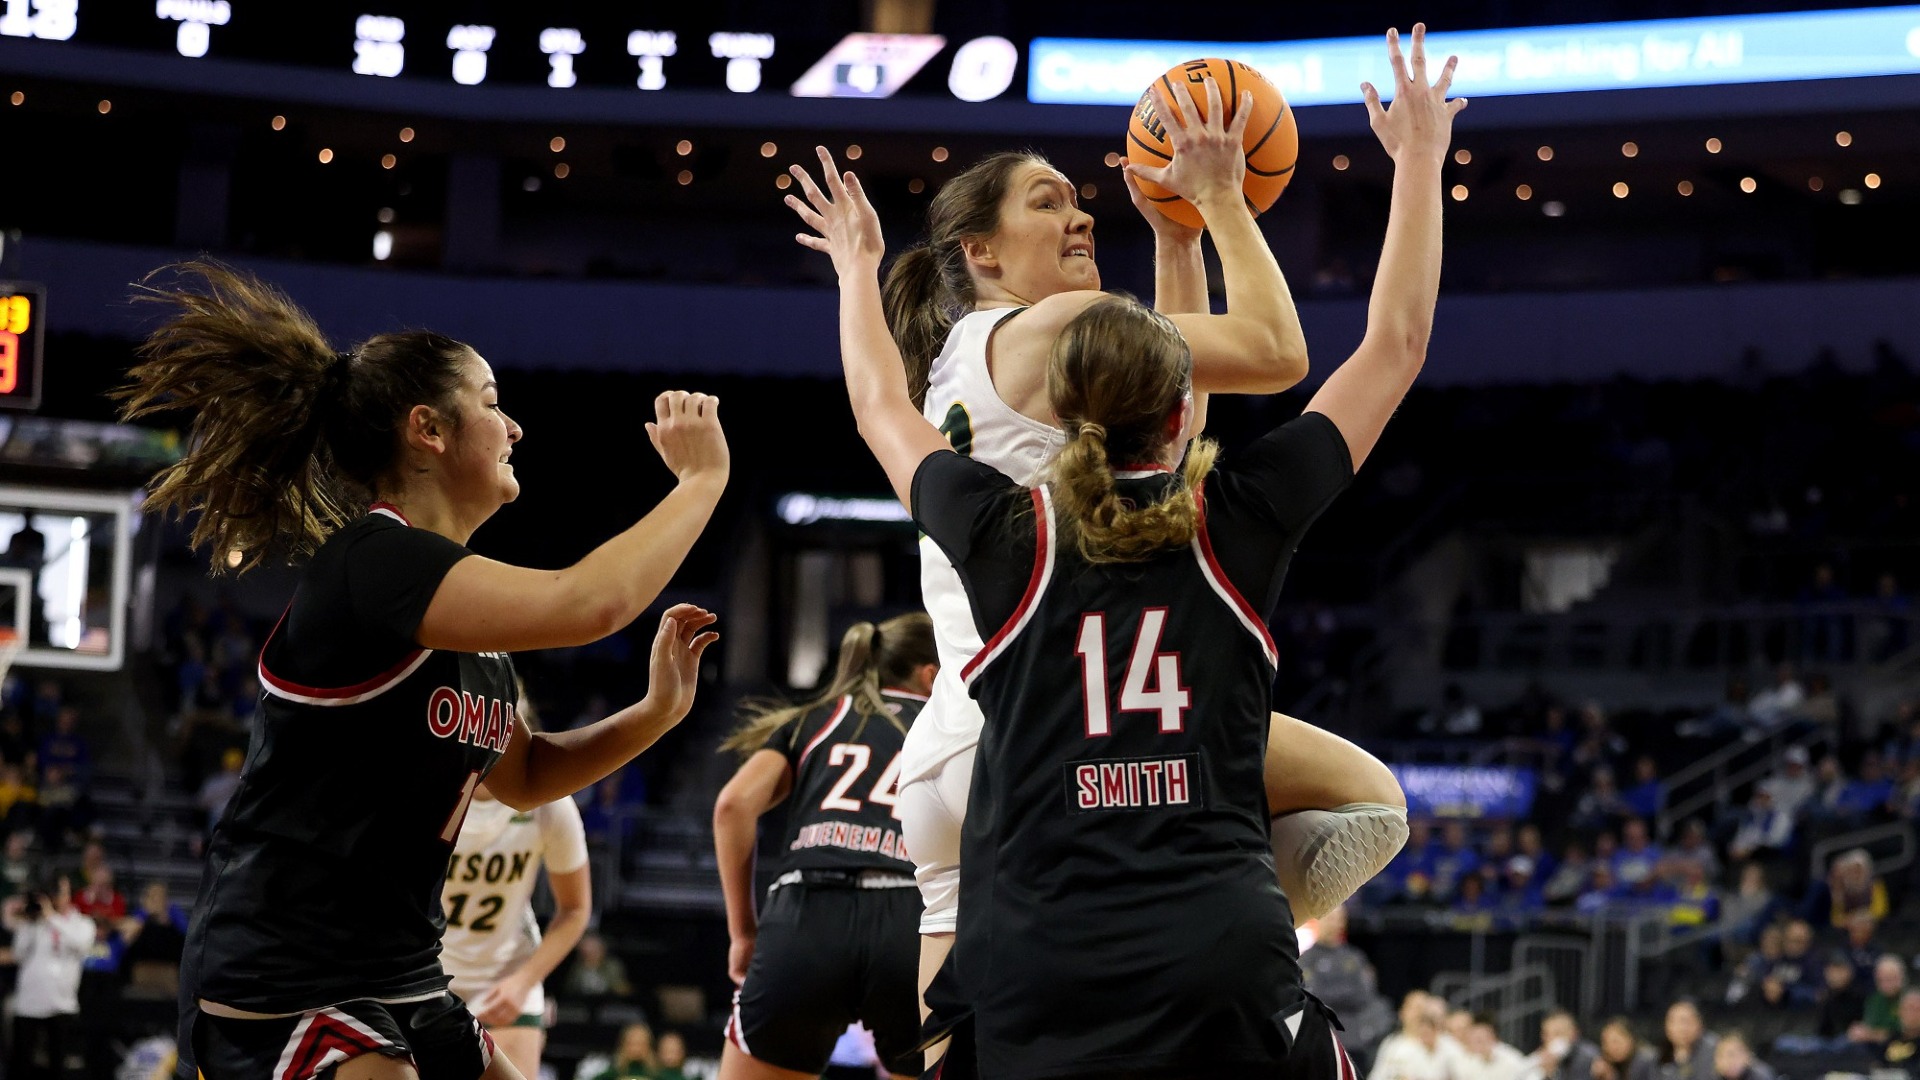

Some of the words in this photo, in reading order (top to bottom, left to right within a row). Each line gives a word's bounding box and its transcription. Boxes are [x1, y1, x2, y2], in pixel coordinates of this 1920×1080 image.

[1074, 606, 1192, 739] 14
[1076, 758, 1190, 809] SMITH
[446, 893, 505, 932] 12
